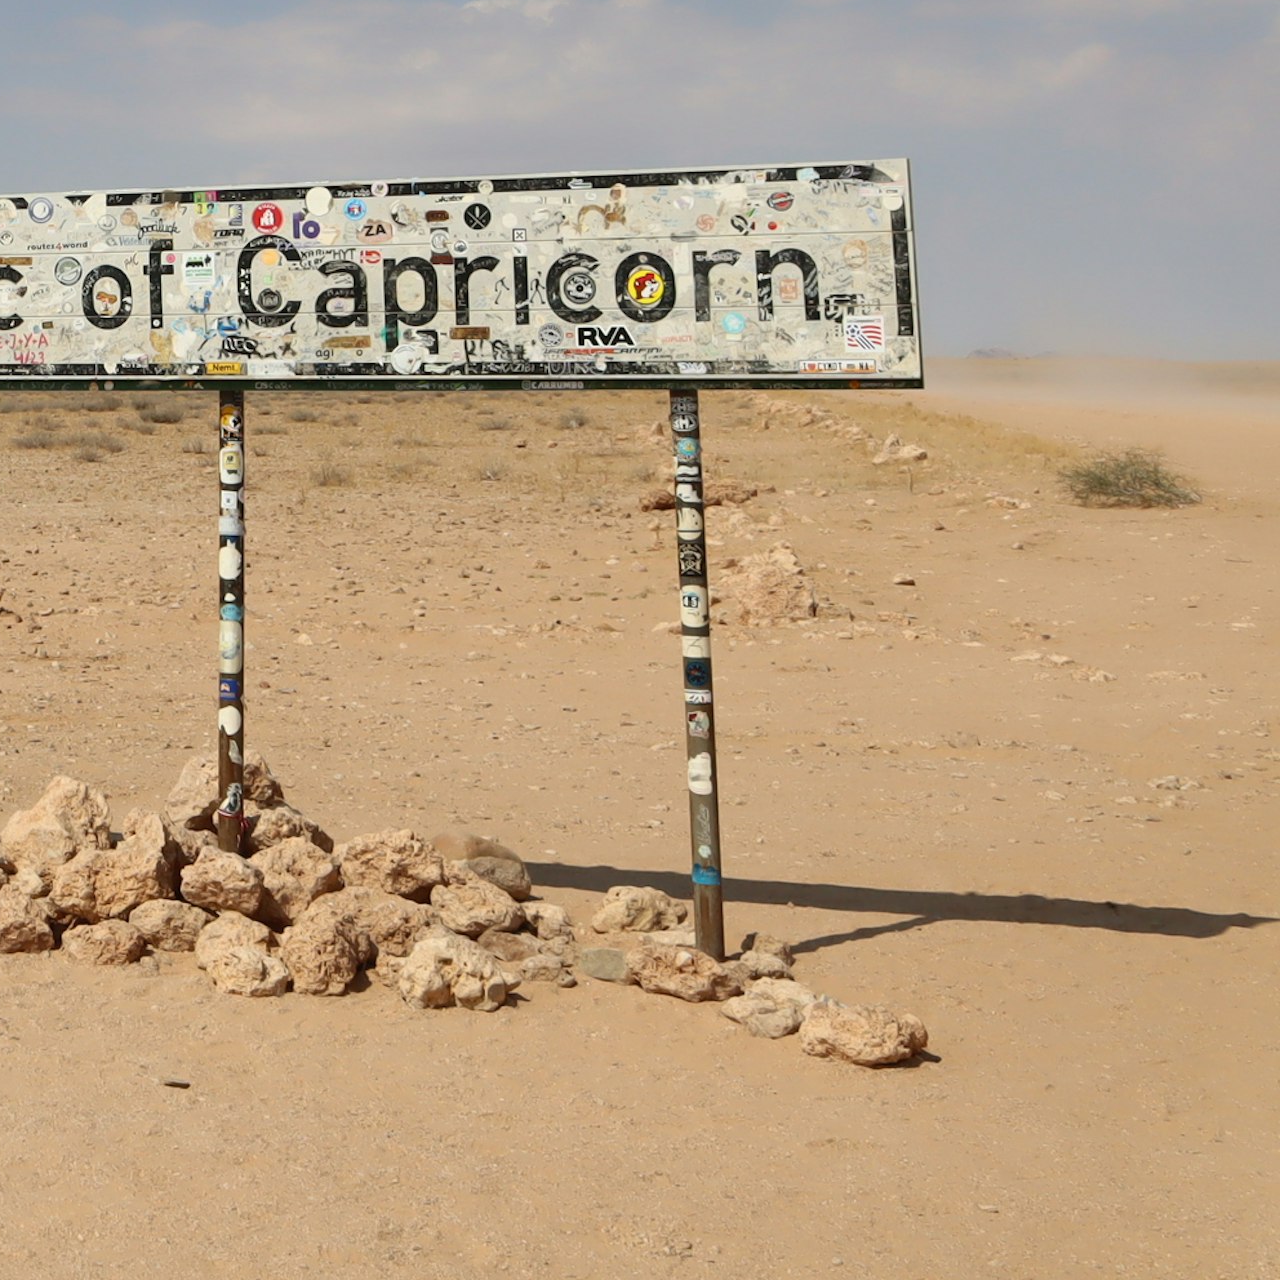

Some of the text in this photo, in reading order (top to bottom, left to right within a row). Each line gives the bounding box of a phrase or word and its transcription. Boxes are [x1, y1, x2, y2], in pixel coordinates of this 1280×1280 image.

[364, 224, 386, 236] ZA
[333, 248, 356, 260] HYT
[81, 238, 175, 331] of
[237, 228, 822, 354] Capricorn
[577, 327, 635, 346] RVA
